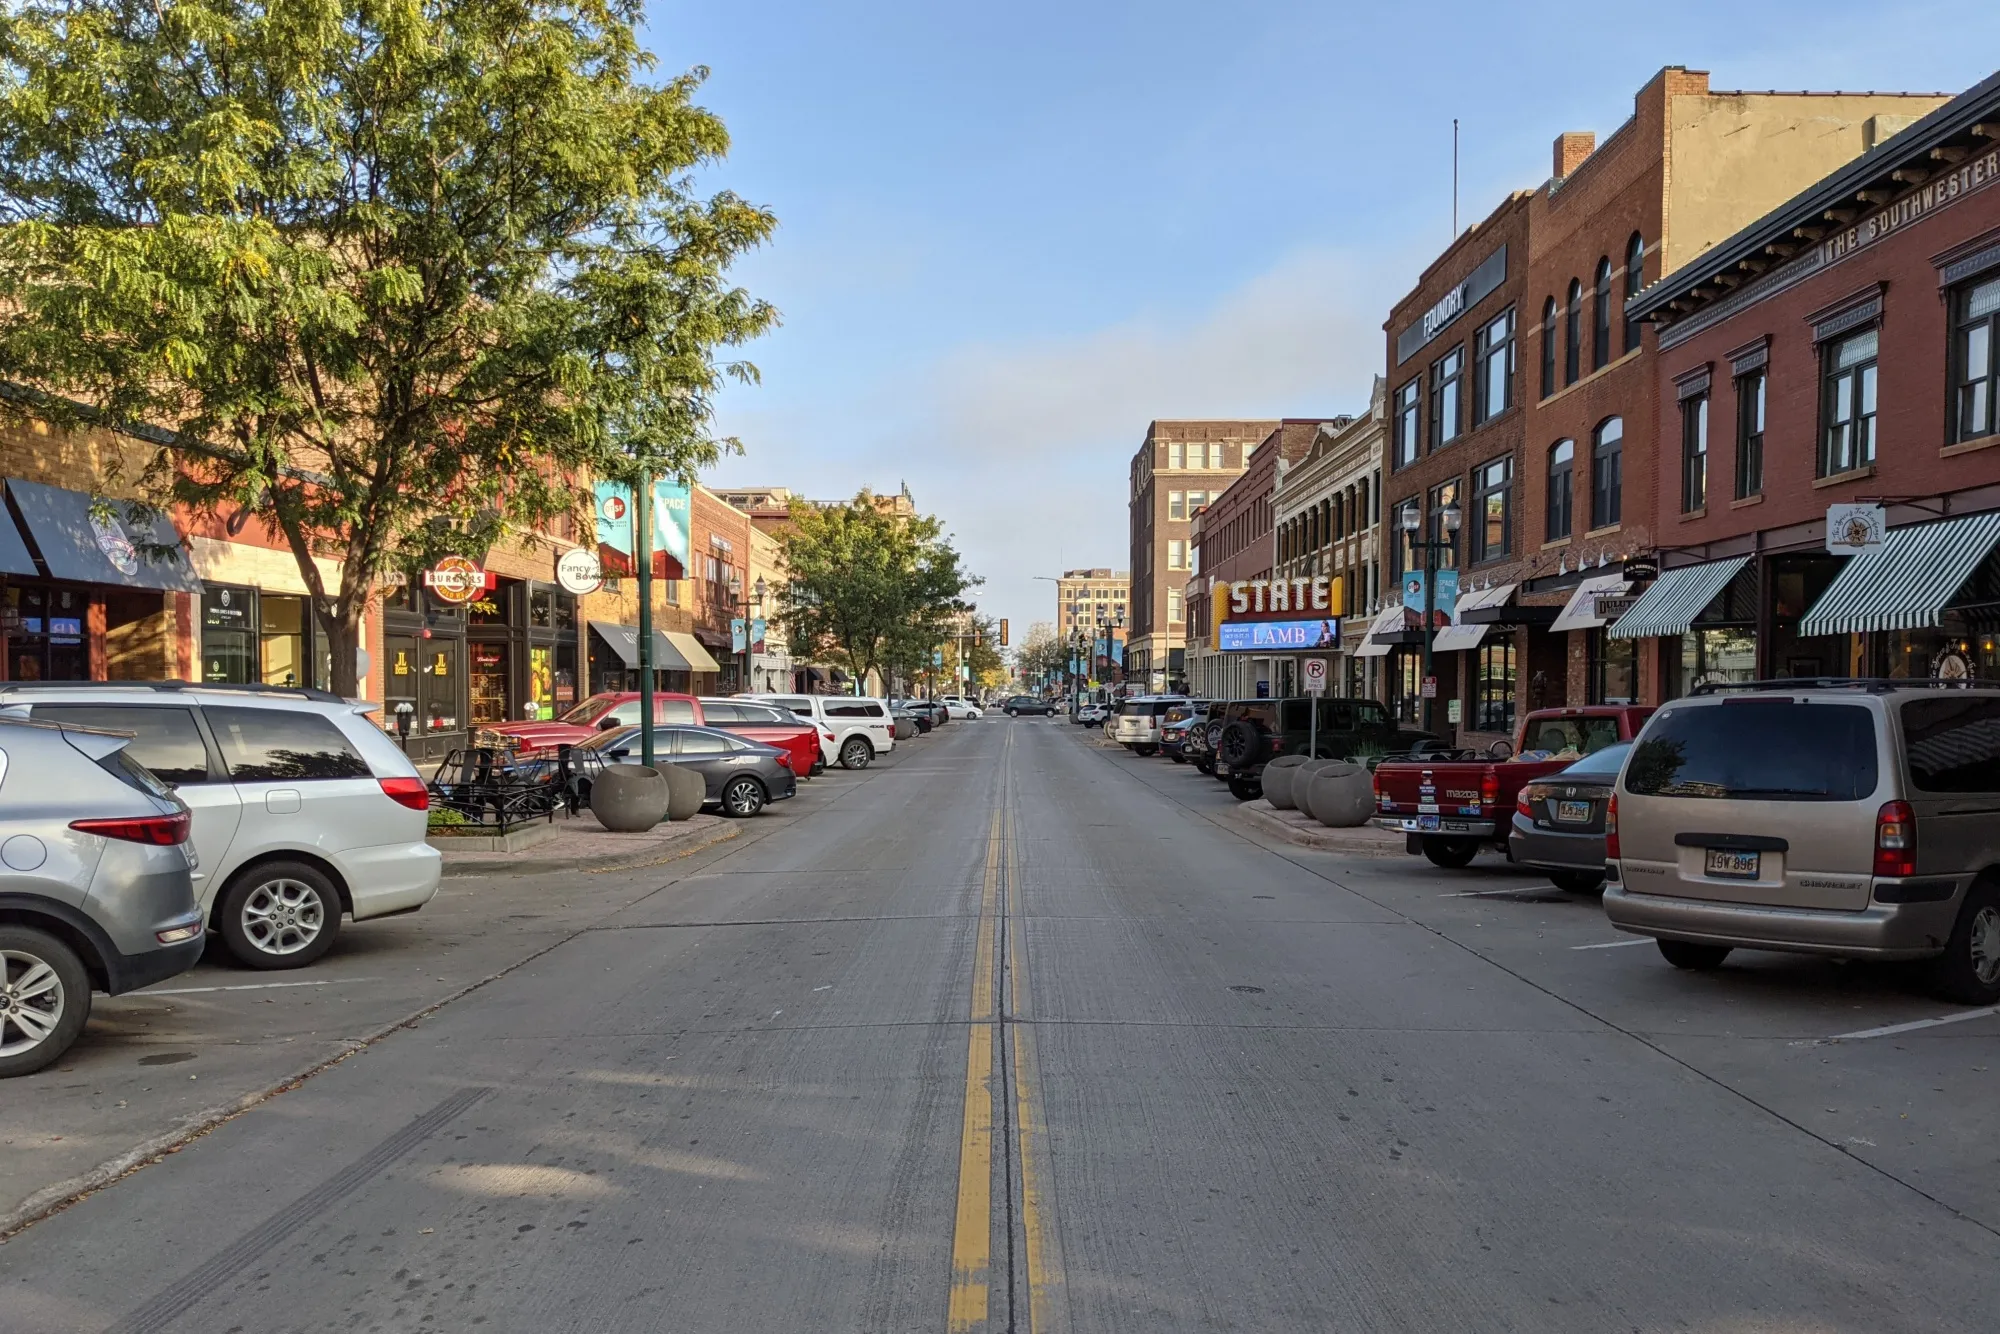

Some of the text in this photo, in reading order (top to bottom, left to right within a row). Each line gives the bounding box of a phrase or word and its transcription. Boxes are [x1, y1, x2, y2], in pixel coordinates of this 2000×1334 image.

[1827, 151, 2000, 260] THE SOUTHWESTER
[1423, 283, 1466, 337] FOUNDRY
[561, 565, 591, 573] Fancy
[429, 574, 482, 583] BURGRS
[1231, 575, 1329, 613] STATE
[1599, 600, 1634, 614] DULUT
[1253, 627, 1306, 645] LAMB
[1711, 856, 1754, 871] 19W 896
